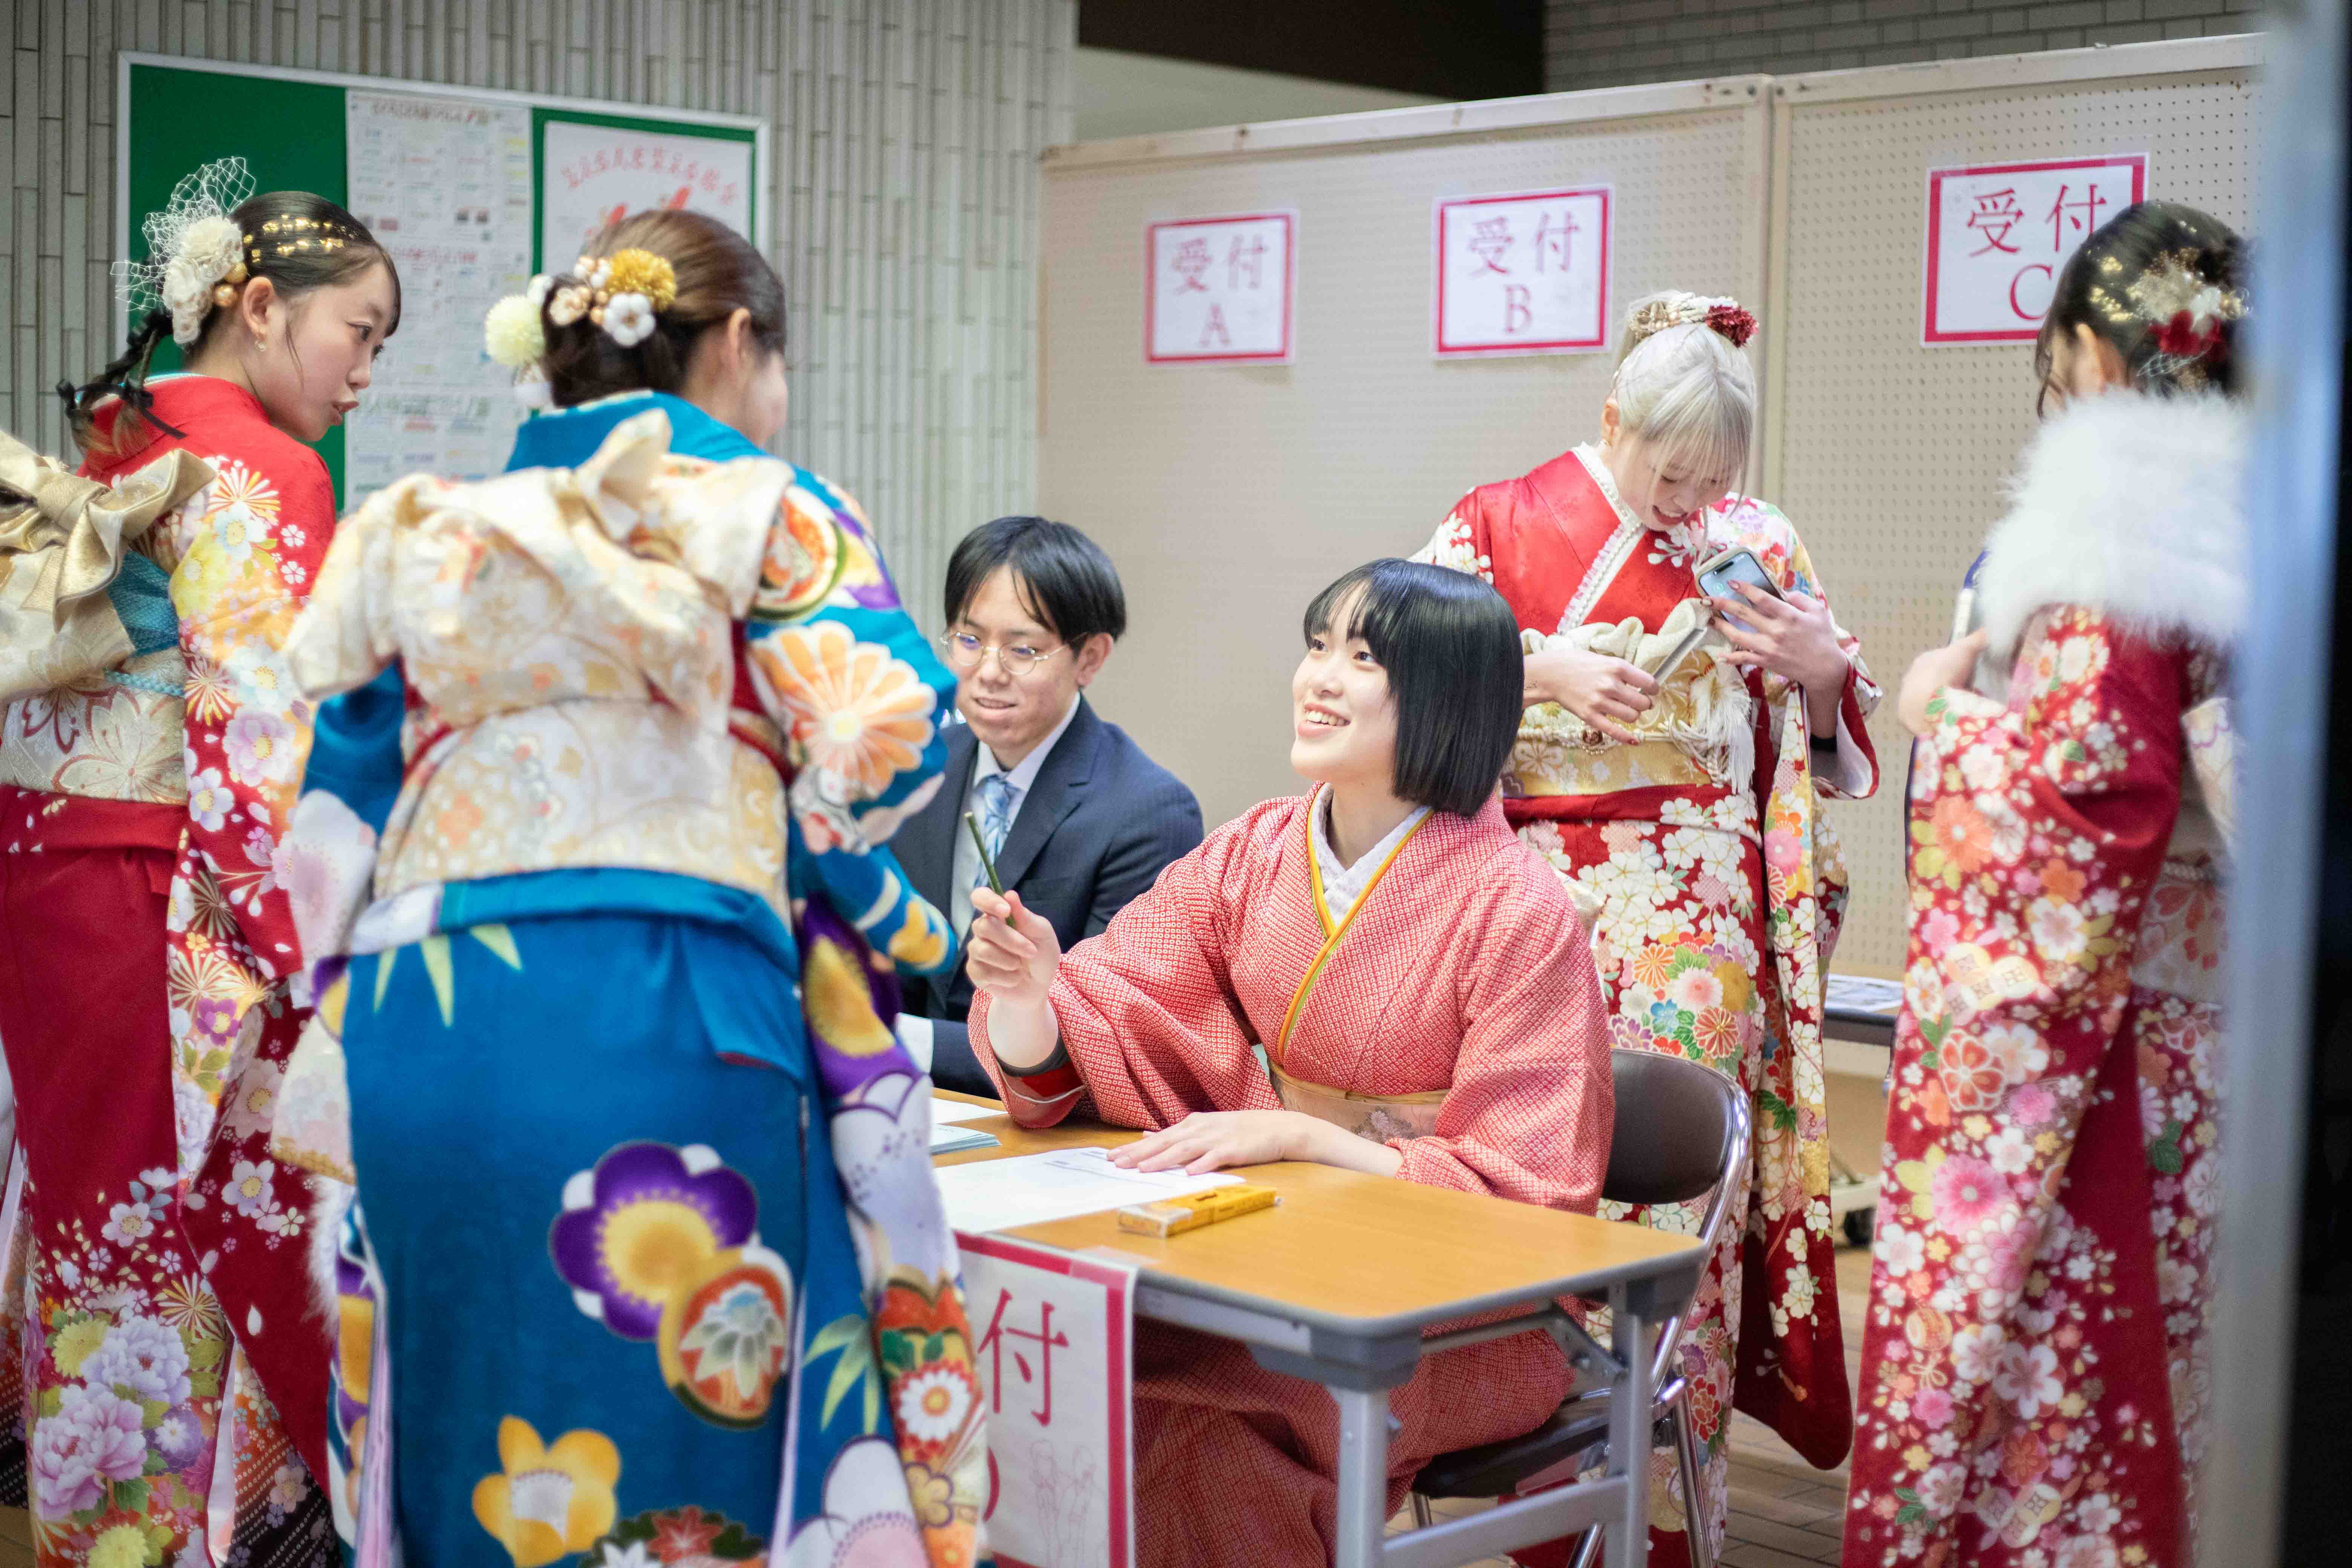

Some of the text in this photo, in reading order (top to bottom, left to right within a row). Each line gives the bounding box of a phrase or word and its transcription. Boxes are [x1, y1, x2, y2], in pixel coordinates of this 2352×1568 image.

[1466, 210, 1582, 278] 受付
[1967, 184, 2107, 257] 受付
[1170, 233, 1269, 296] 受付
[2009, 263, 2054, 320] C
[1198, 303, 1231, 348] A
[1503, 284, 1533, 334] B
[977, 1287, 1069, 1427] 付
